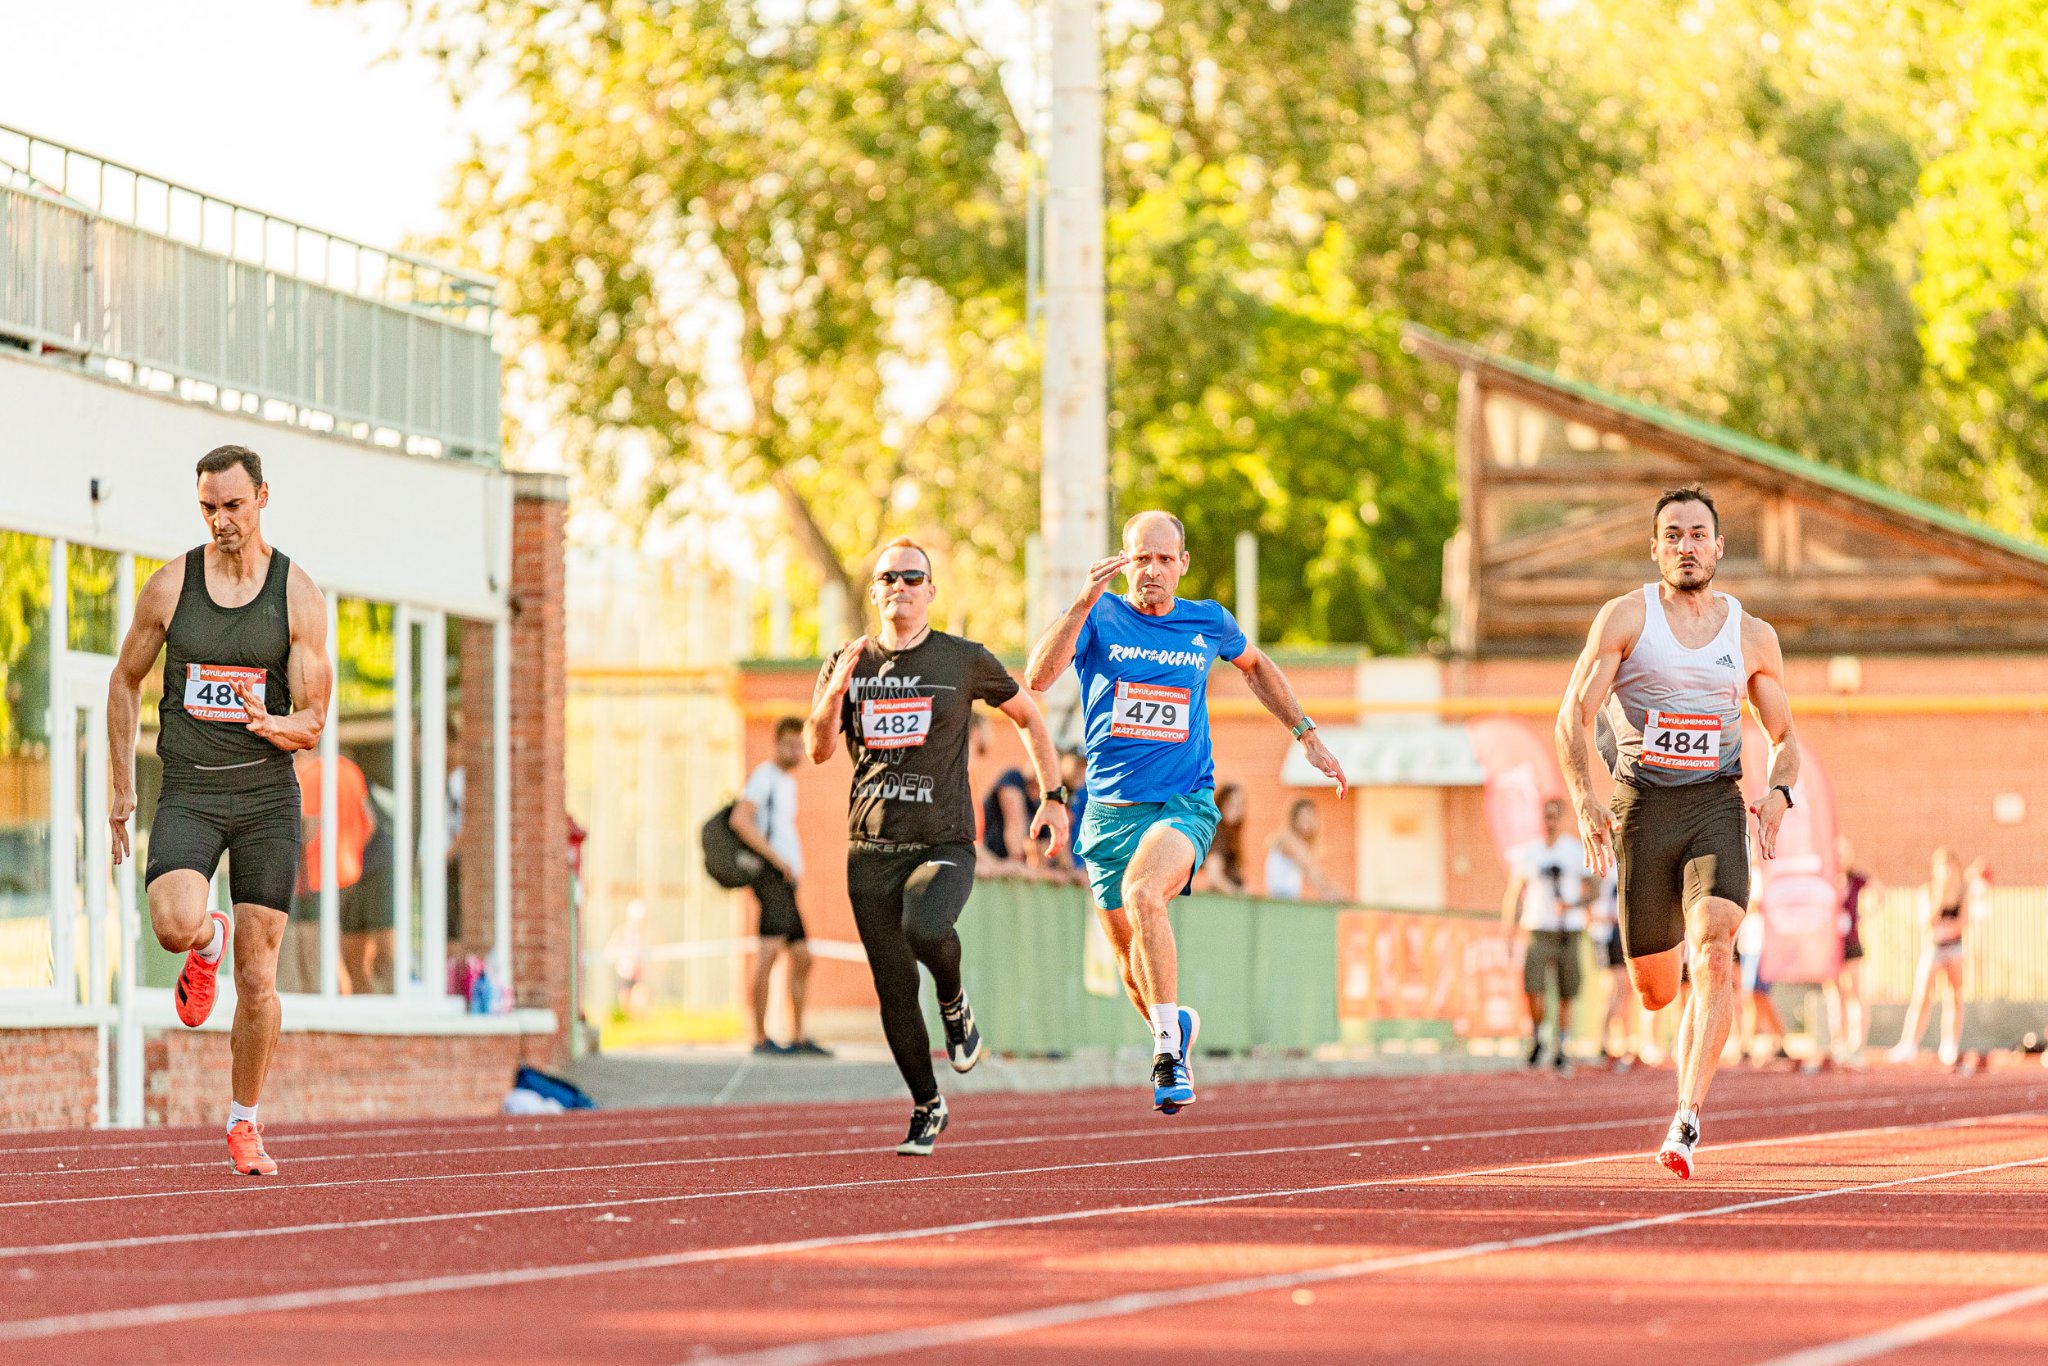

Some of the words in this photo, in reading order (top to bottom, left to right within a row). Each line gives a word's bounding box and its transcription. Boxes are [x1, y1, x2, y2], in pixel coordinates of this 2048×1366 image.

[1159, 650, 1206, 671] OCEANS
[848, 675, 922, 703] WORK
[1128, 687, 1188, 700] #GYULAIMEMORIAL
[1125, 701, 1177, 726] 479
[1658, 716, 1719, 726] #GYULAIMEMORIAL
[874, 714, 919, 735] 482
[1114, 727, 1185, 739] #ATLETAVAGYOK
[1654, 730, 1710, 755] 484
[1645, 755, 1715, 767] #ATLETAVAGYOK
[856, 840, 895, 853] NIKE
[896, 841, 928, 853] PR
